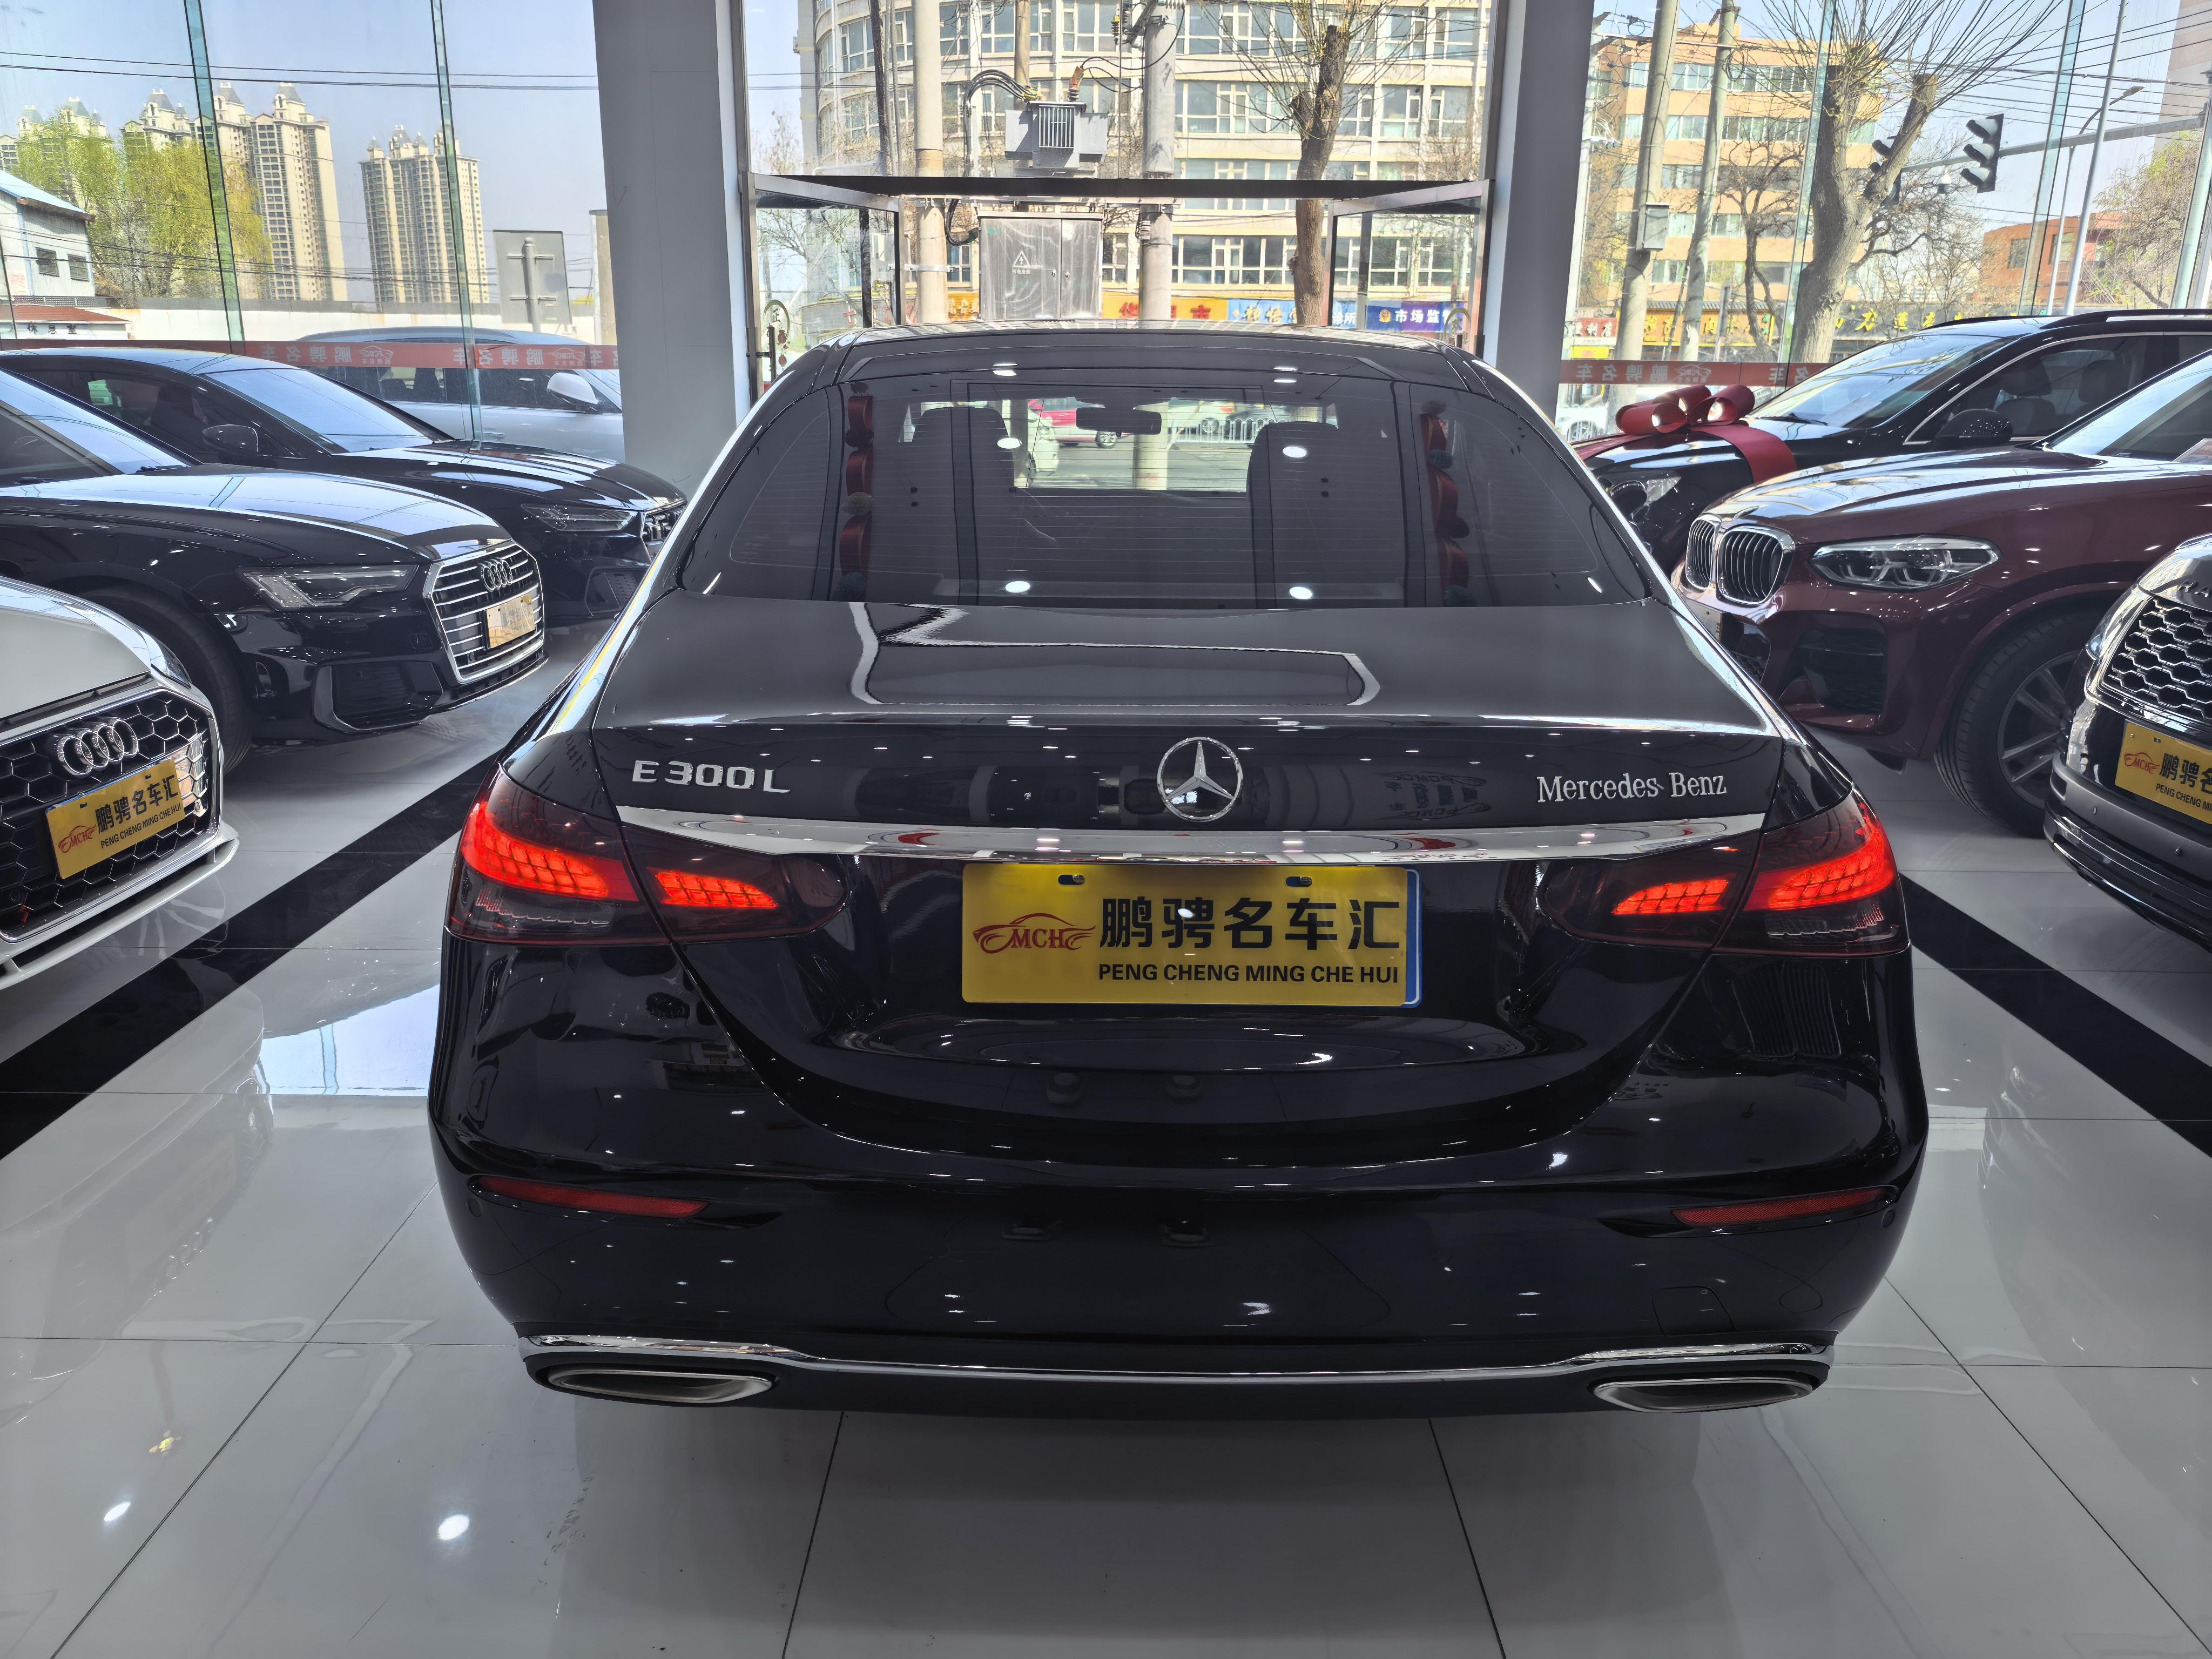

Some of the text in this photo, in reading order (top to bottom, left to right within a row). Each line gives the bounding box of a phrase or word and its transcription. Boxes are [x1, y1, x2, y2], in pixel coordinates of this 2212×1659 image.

[28, 322, 77, 334] 休息室
[96, 774, 179, 834] 鹏骋名车汇
[2156, 783, 2175, 797] PENG
[2176, 791, 2202, 808] CHENG
[100, 802, 182, 849] PENG CHENG MING CHE HUI
[1100, 896, 1400, 950] 鹏骋名车汇
[1098, 963, 1398, 983] PENG CHENG MING CHE HUI
